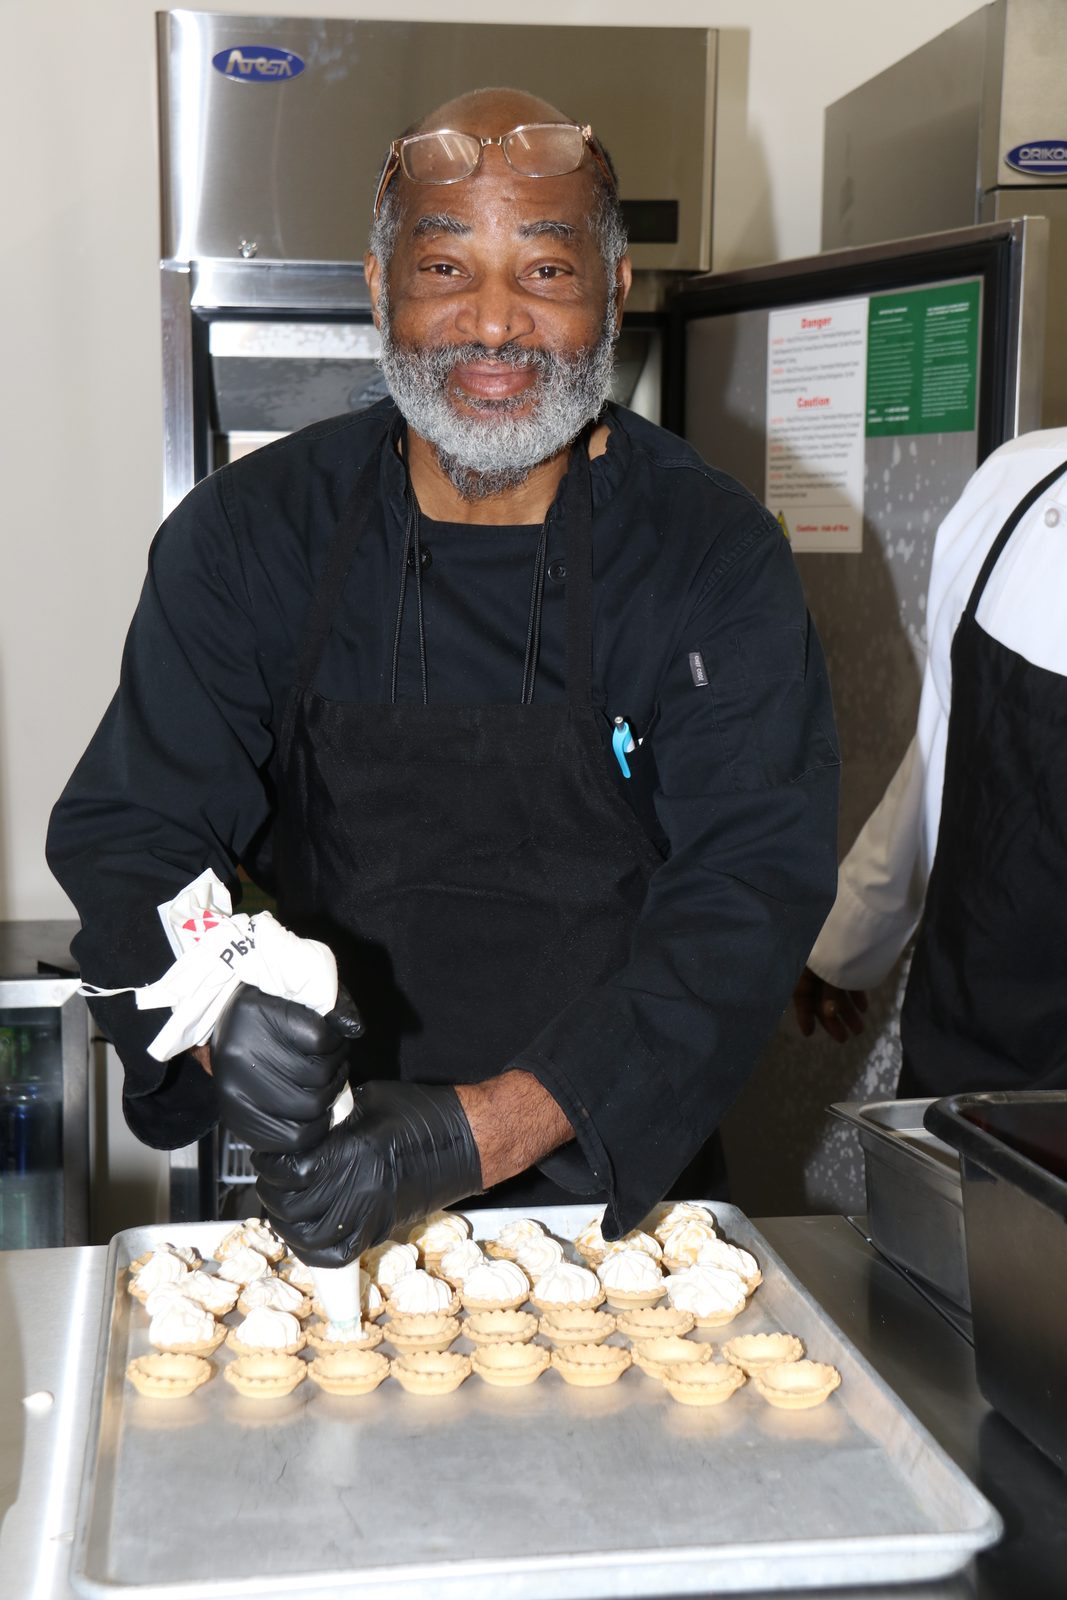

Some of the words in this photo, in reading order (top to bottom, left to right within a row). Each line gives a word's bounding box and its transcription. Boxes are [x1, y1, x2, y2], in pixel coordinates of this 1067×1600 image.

[1019, 148, 1067, 160] ORIKO
[801, 317, 831, 329] Danger
[797, 397, 829, 408] Caution
